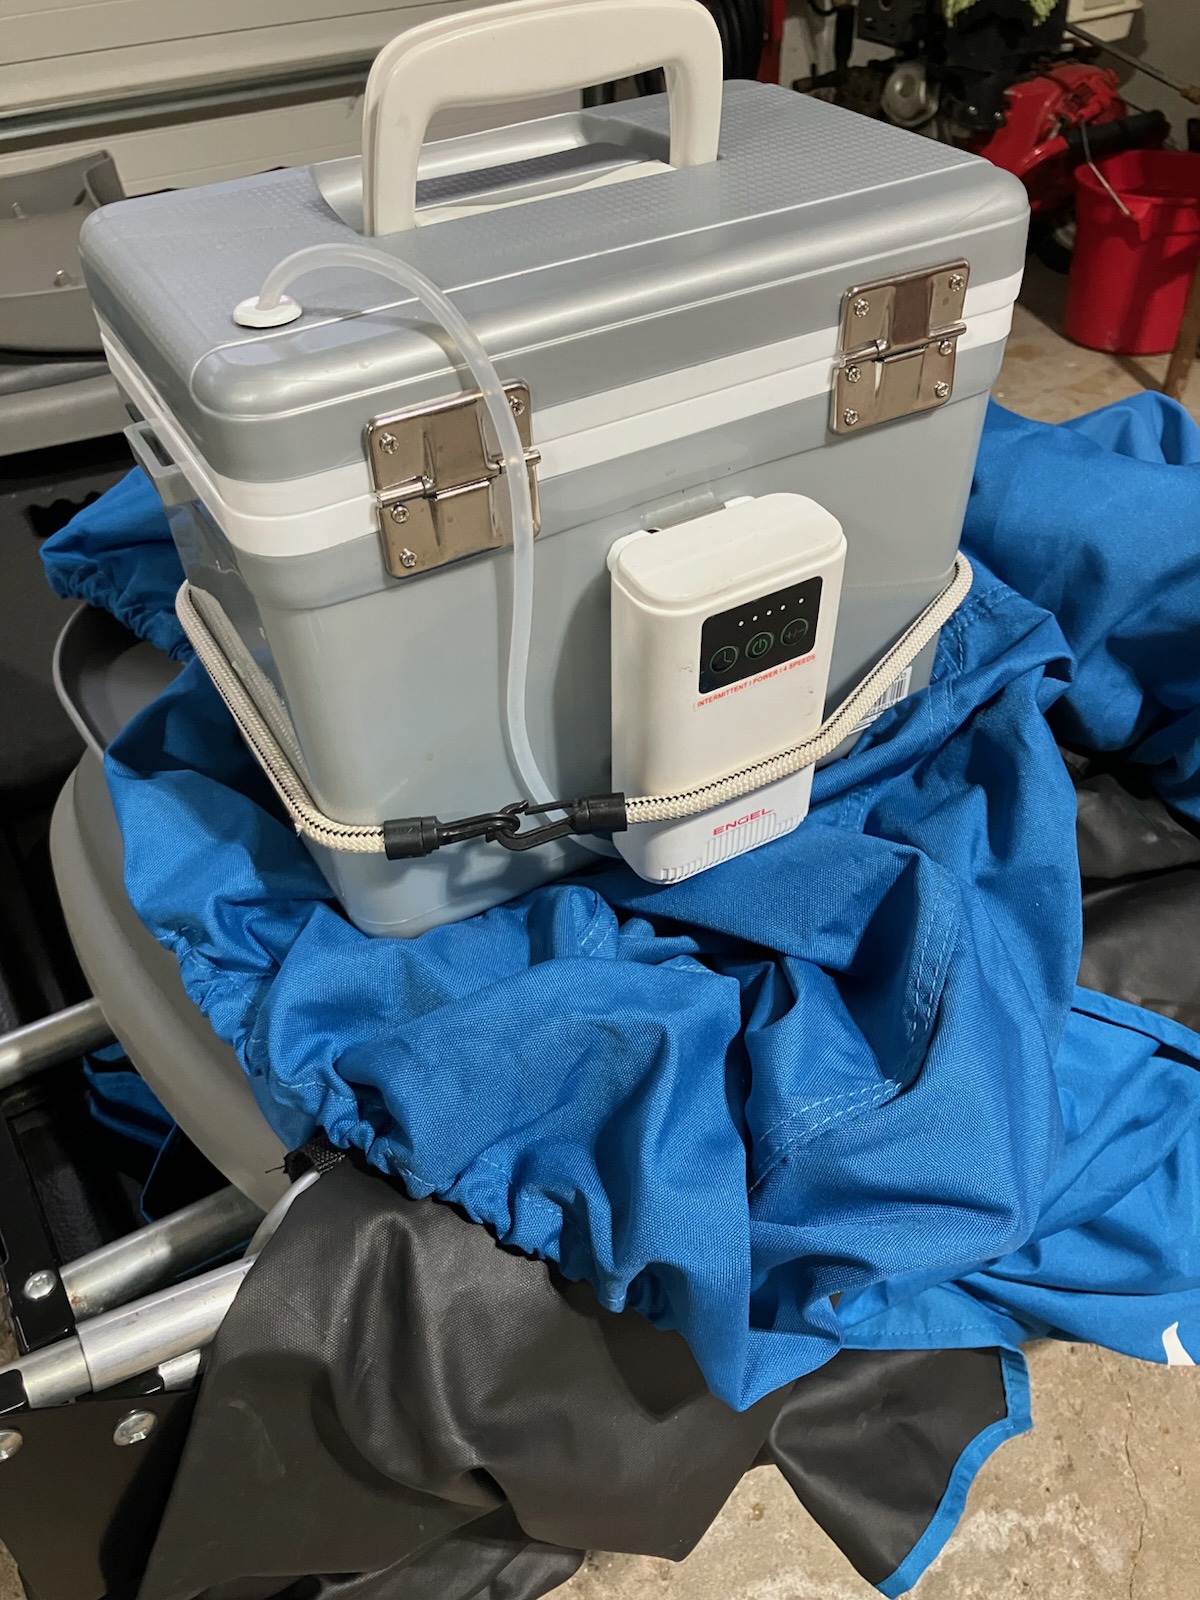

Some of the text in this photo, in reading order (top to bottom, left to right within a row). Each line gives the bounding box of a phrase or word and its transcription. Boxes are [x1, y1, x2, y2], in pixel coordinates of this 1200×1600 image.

[697, 682, 749, 707] INTERMITTENT
[753, 670, 778, 684] POWER
[789, 653, 816, 670] SPEEDS
[713, 808, 774, 836] ENGEL
